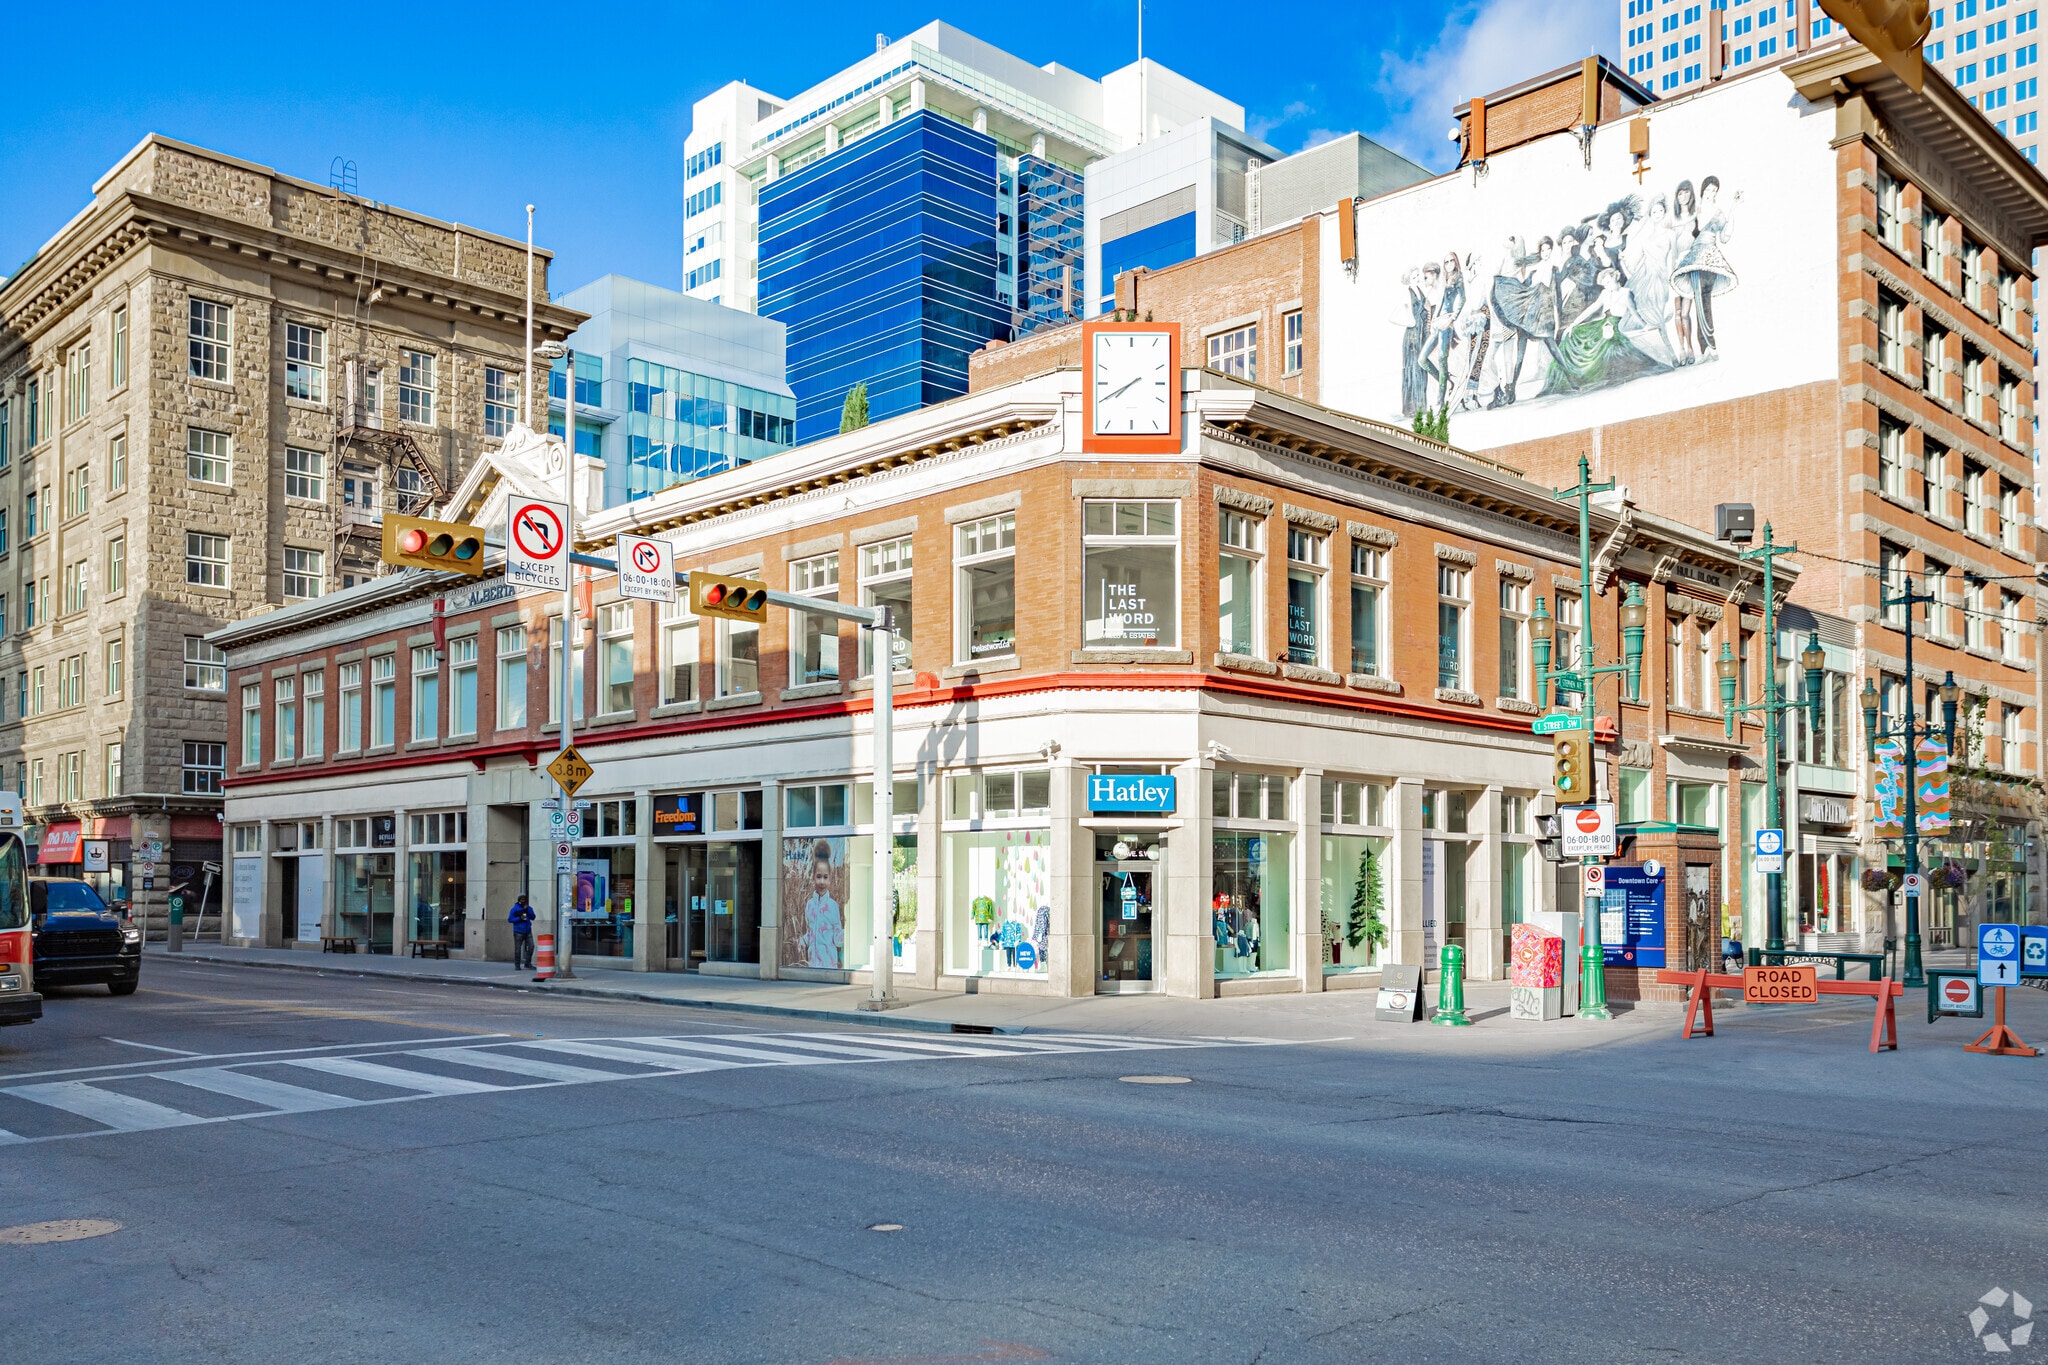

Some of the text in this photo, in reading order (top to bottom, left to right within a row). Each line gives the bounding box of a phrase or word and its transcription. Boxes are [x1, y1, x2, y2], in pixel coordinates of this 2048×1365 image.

[520, 560, 555, 574] EXCEPT
[514, 571, 560, 586] BICYCLES
[622, 573, 671, 588] 06:00-18:00
[1697, 571, 1721, 587] BLOCK
[469, 583, 516, 606] ALBERTA
[624, 585, 671, 597] EXCEPT BY PERMIT
[1108, 584, 1137, 596] THE
[1109, 598, 1146, 610] LAST
[1289, 605, 1305, 618] THE
[1108, 613, 1154, 625] WORD
[1289, 618, 1311, 632] LAST
[892, 640, 906, 652] RD
[1289, 633, 1315, 646] WORD
[1537, 719, 1578, 731] 1 STREET SW
[1092, 778, 1170, 808] Hatley
[655, 808, 696, 824] Freedom
[1566, 835, 1611, 844] 06:00-18:00
[1618, 877, 1659, 885] Downtown Core
[1422, 919, 1438, 928] LLIED
[1757, 970, 1802, 983] ROAD
[1748, 985, 1812, 998] CLOSED
